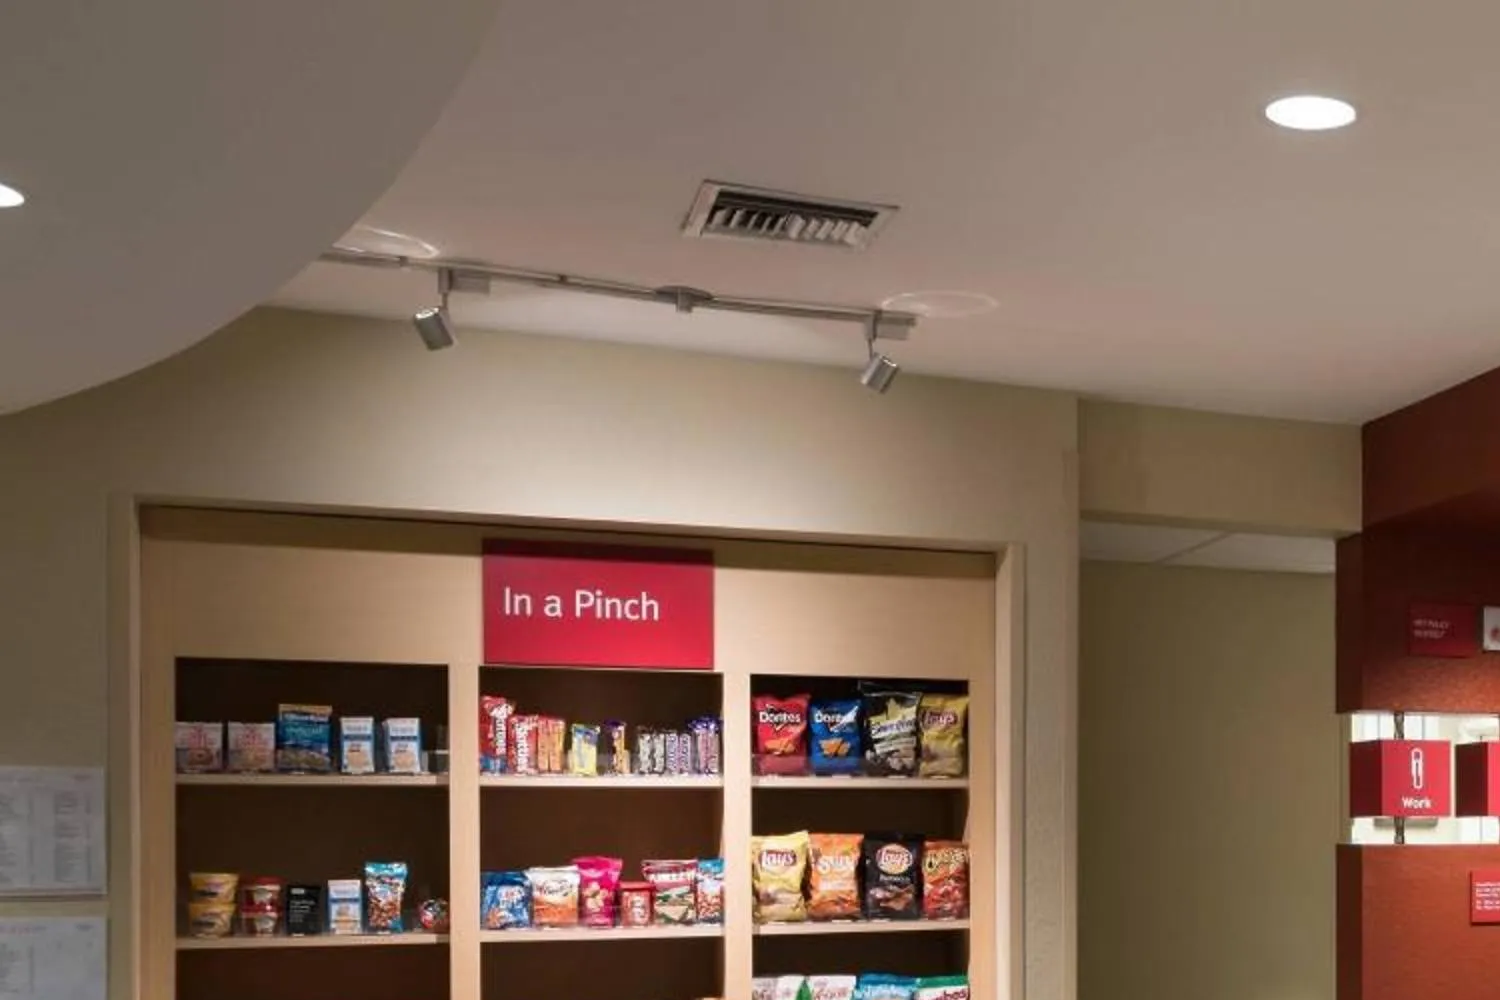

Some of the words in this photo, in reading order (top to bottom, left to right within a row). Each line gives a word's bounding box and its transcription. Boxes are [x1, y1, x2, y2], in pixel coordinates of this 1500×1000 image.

[504, 587, 532, 616] In
[543, 595, 563, 618] a
[574, 589, 660, 621] Pinch
[758, 710, 802, 724] Doritos
[1401, 796, 1432, 810] Work
